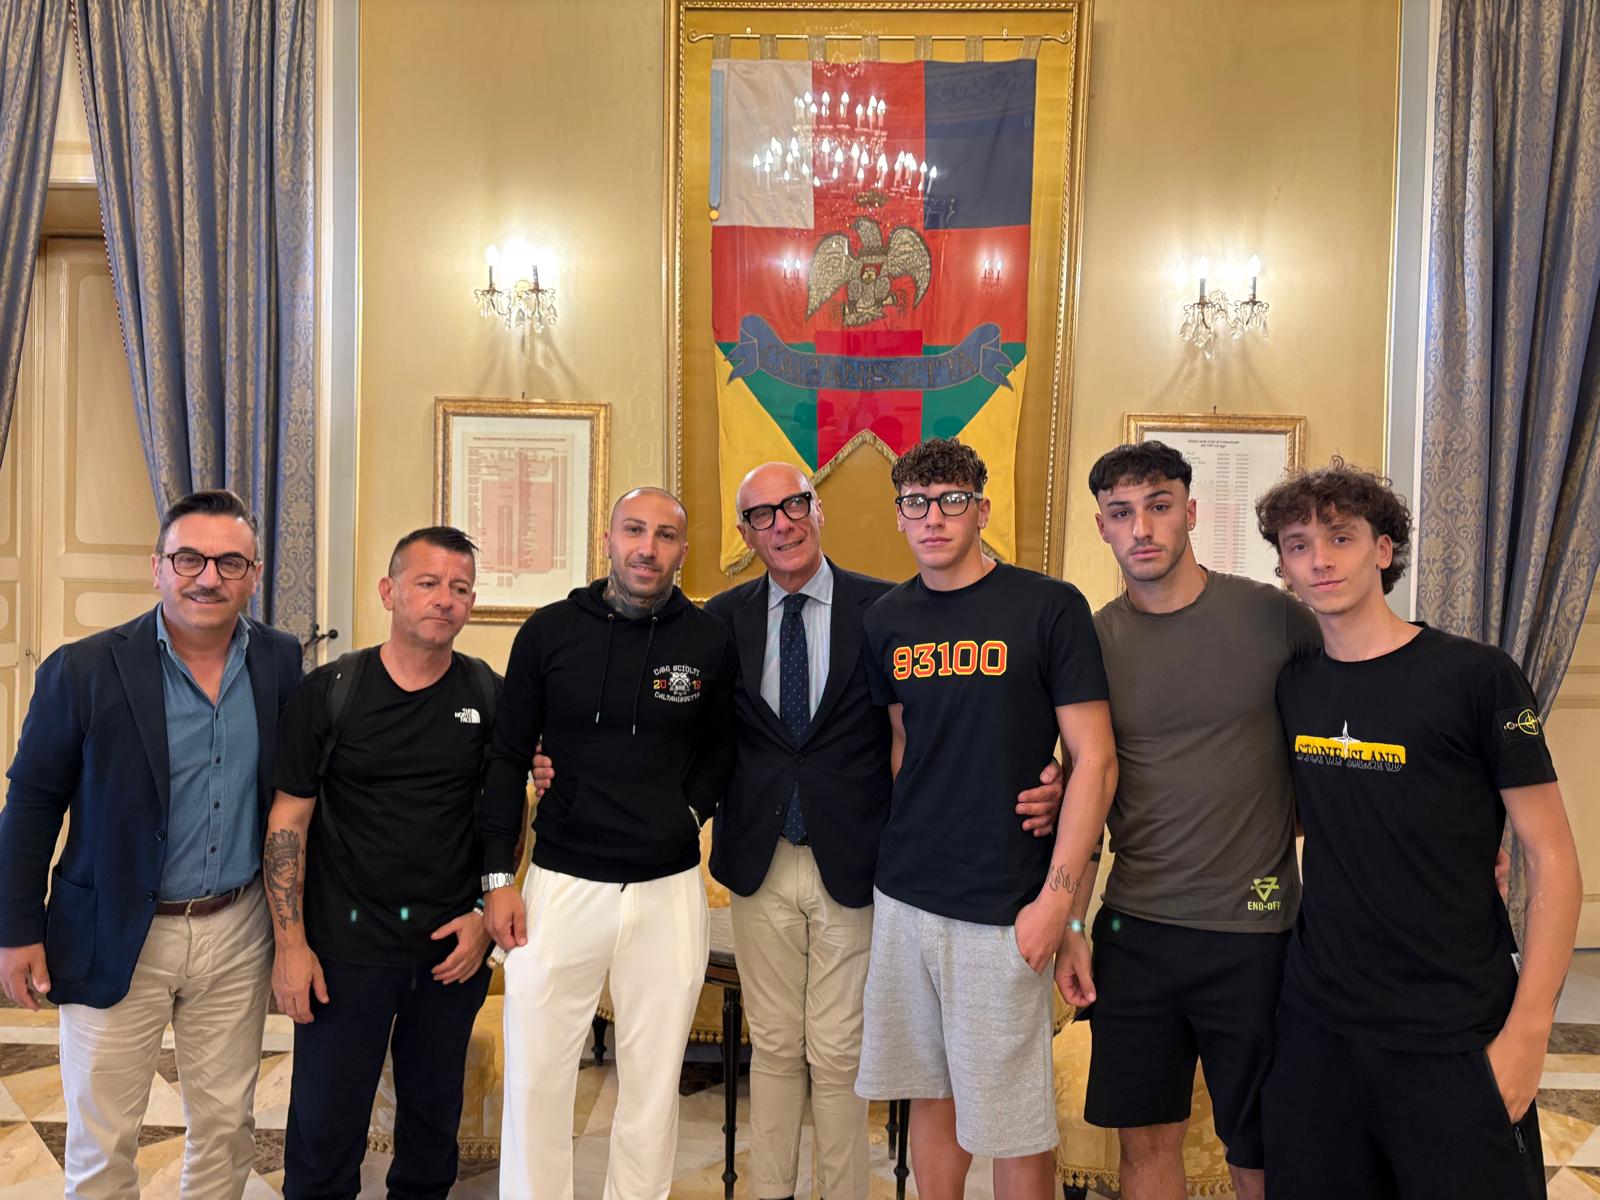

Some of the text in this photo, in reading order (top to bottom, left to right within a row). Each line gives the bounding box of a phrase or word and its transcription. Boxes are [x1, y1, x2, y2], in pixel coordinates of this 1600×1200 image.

[893, 640, 1008, 681] 93100
[653, 679, 666, 689] 20
[1296, 743, 1403, 772] STONE ISLAND
[1247, 901, 1281, 911] END-OFF
